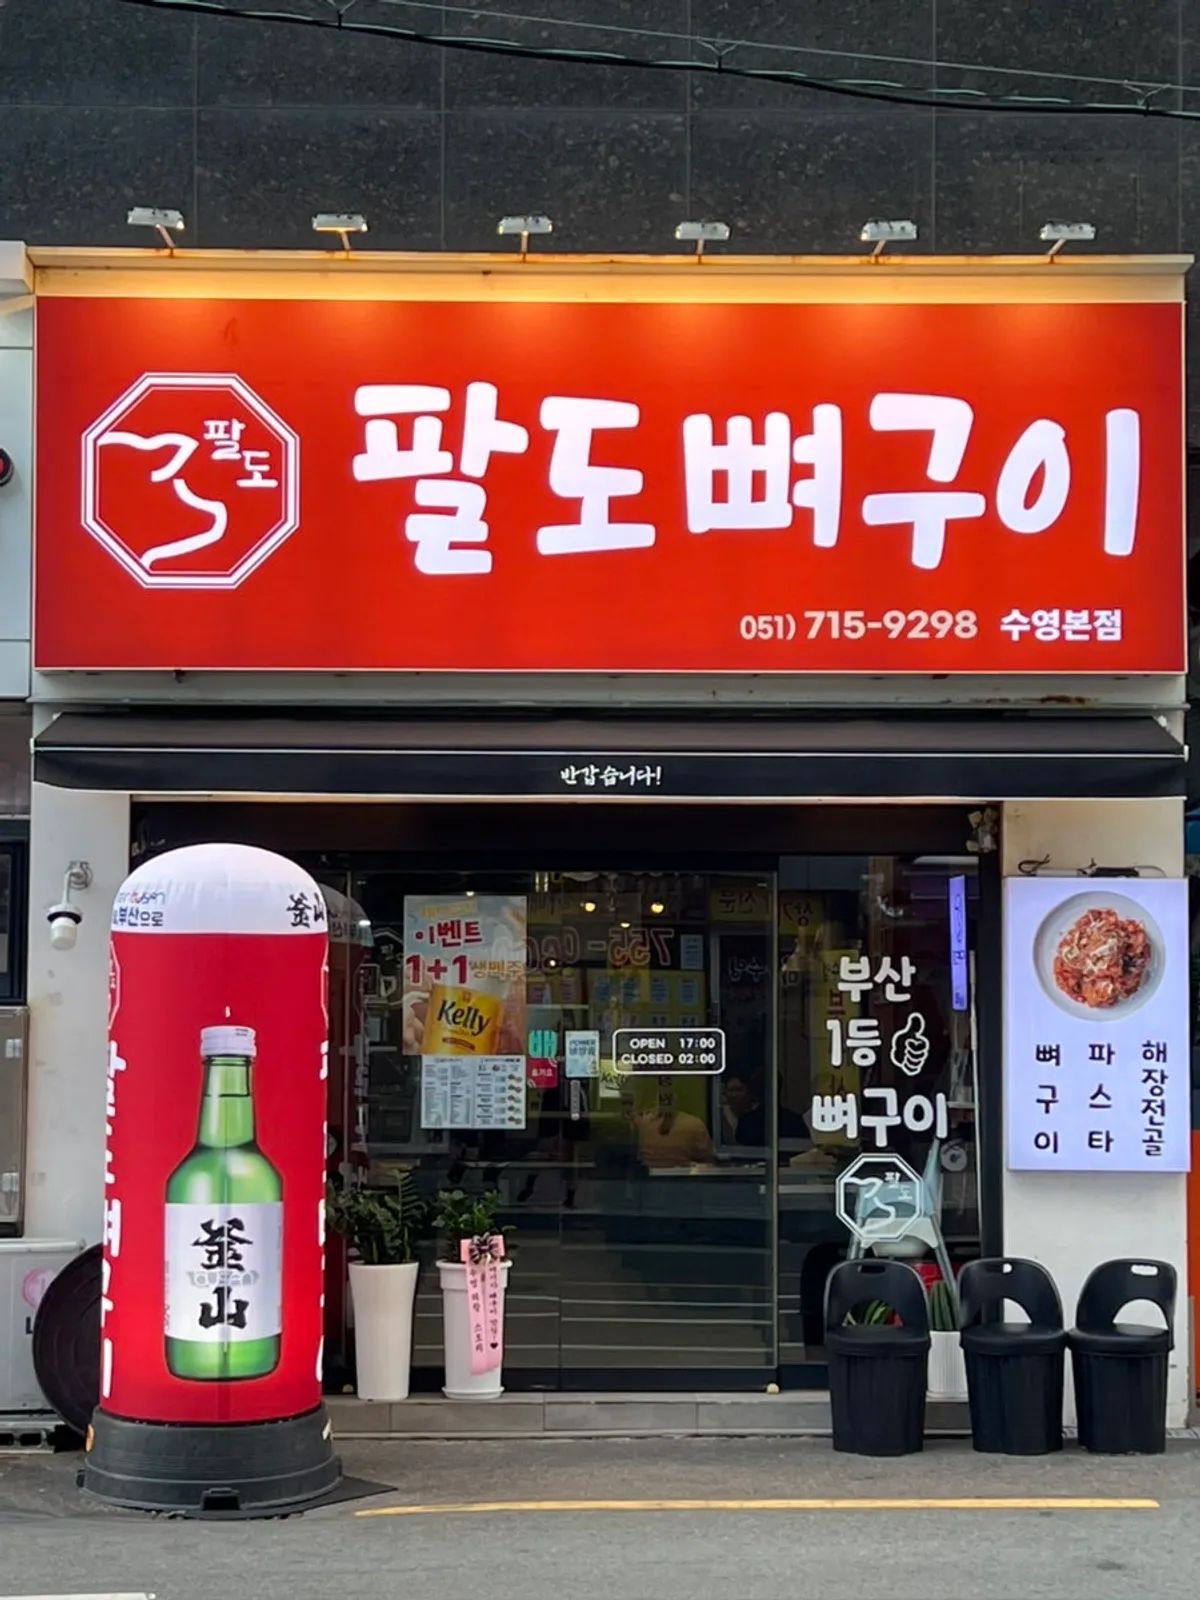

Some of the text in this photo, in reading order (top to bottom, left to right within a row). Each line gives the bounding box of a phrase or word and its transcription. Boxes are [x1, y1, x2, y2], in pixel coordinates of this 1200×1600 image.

[203, 417, 279, 489] 팔도
[740, 608, 1123, 643] 051) 715-9298 수영본점
[560, 764, 662, 787] 반갑습니다!
[415, 919, 483, 948] 이벤트
[406, 954, 469, 985] 1+1
[837, 955, 916, 1002] 부산
[437, 999, 492, 1037] Kelly
[621, 1053, 716, 1065] CLOSED 02:00
[629, 1037, 716, 1049] OPEN 17:00
[825, 1018, 882, 1067] 1등
[811, 1088, 949, 1148] 뼈구이
[1033, 1043, 1062, 1154] 뼈구이
[1087, 1043, 1116, 1153] 파스타
[1140, 1040, 1169, 1157] 해장전골
[191, 1217, 253, 1330] 釜山
